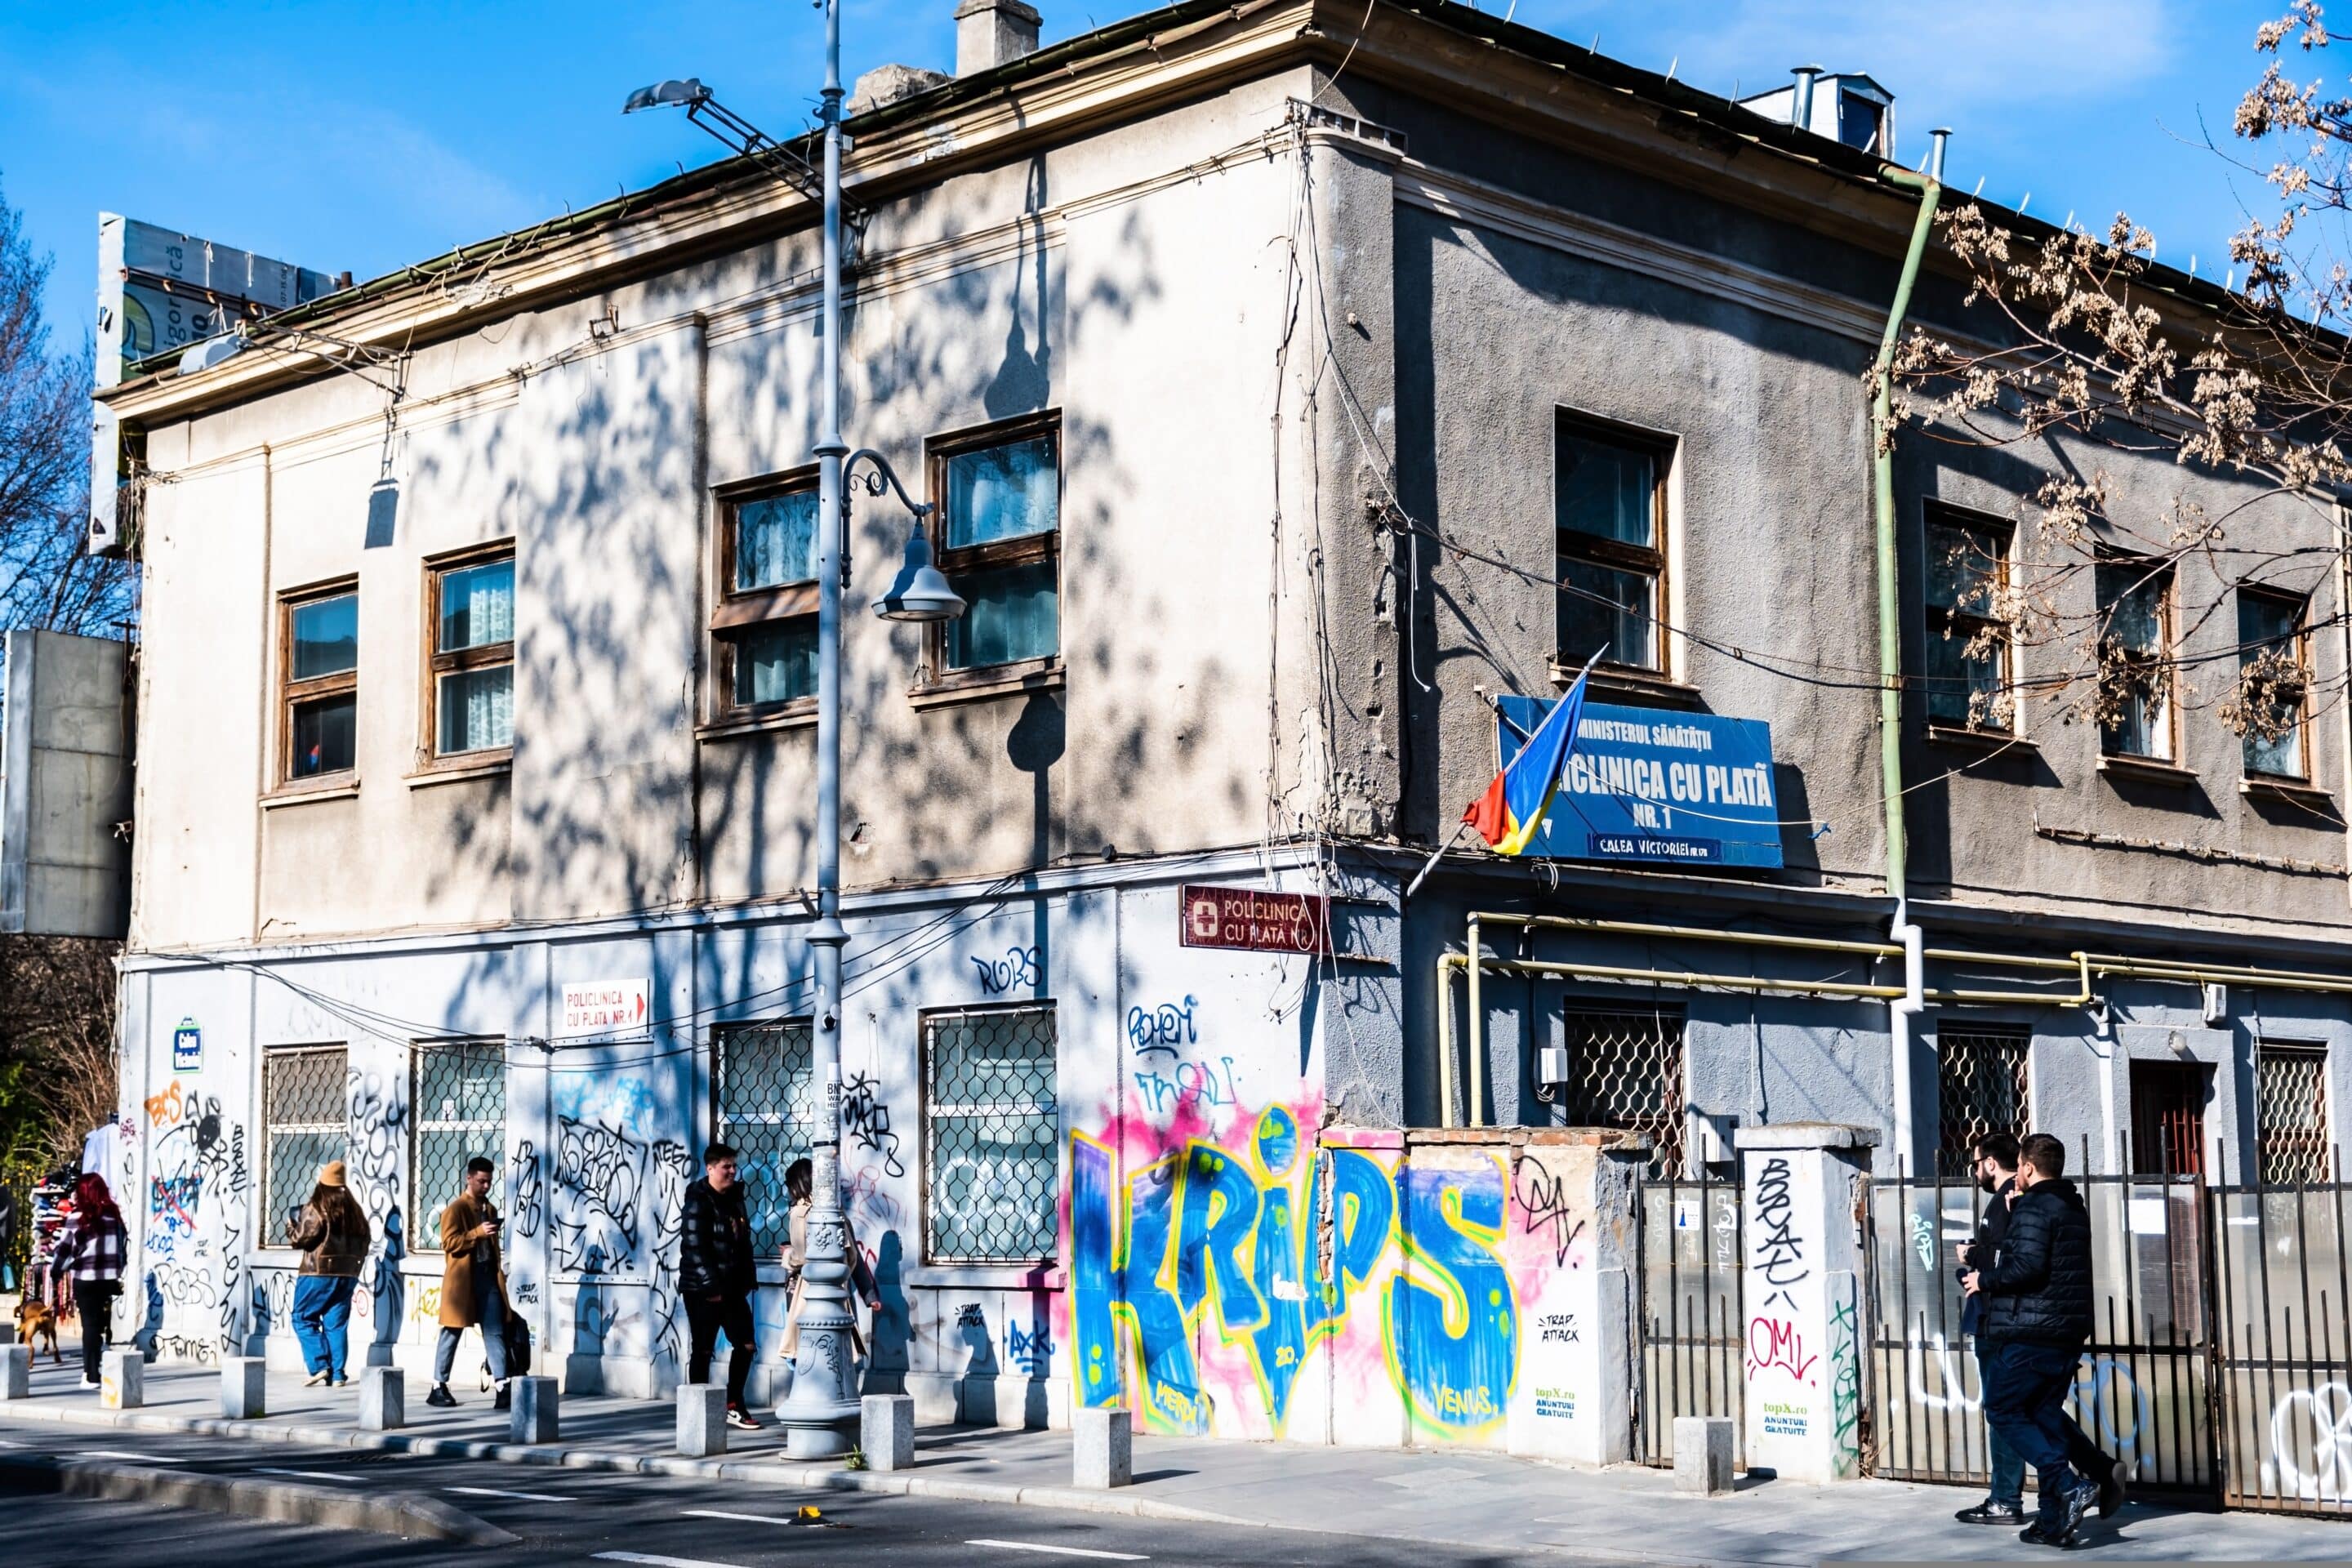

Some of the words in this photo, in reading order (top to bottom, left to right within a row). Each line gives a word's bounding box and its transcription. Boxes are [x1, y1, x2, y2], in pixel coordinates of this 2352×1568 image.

[1577, 719, 1651, 745] MINISTERUL
[1557, 753, 1668, 800] ICLINICA
[1669, 761, 1702, 803] CU
[1633, 803, 1661, 828] NR.
[1663, 806, 1672, 830] 1
[1600, 839, 1633, 853] CALEA
[1638, 840, 1689, 856] VICTORIEI
[1225, 900, 1307, 922] POLICLINICA
[1225, 924, 1244, 941] CU
[568, 991, 622, 1007] POLICLINICA
[568, 1013, 579, 1027] CU
[583, 1012, 608, 1026] PLATA
[1547, 1314, 1575, 1328] TRAP
[1541, 1330, 1580, 1343] ATTACK
[1535, 1388, 1575, 1401] topX.ro
[1536, 1399, 1575, 1410] ANUNTURI
[1763, 1402, 1808, 1415] topX.ro
[1536, 1408, 1574, 1419] GRATUITE
[1764, 1416, 1807, 1427] ANUNTURI
[1765, 1425, 1807, 1436] GRATUITE
